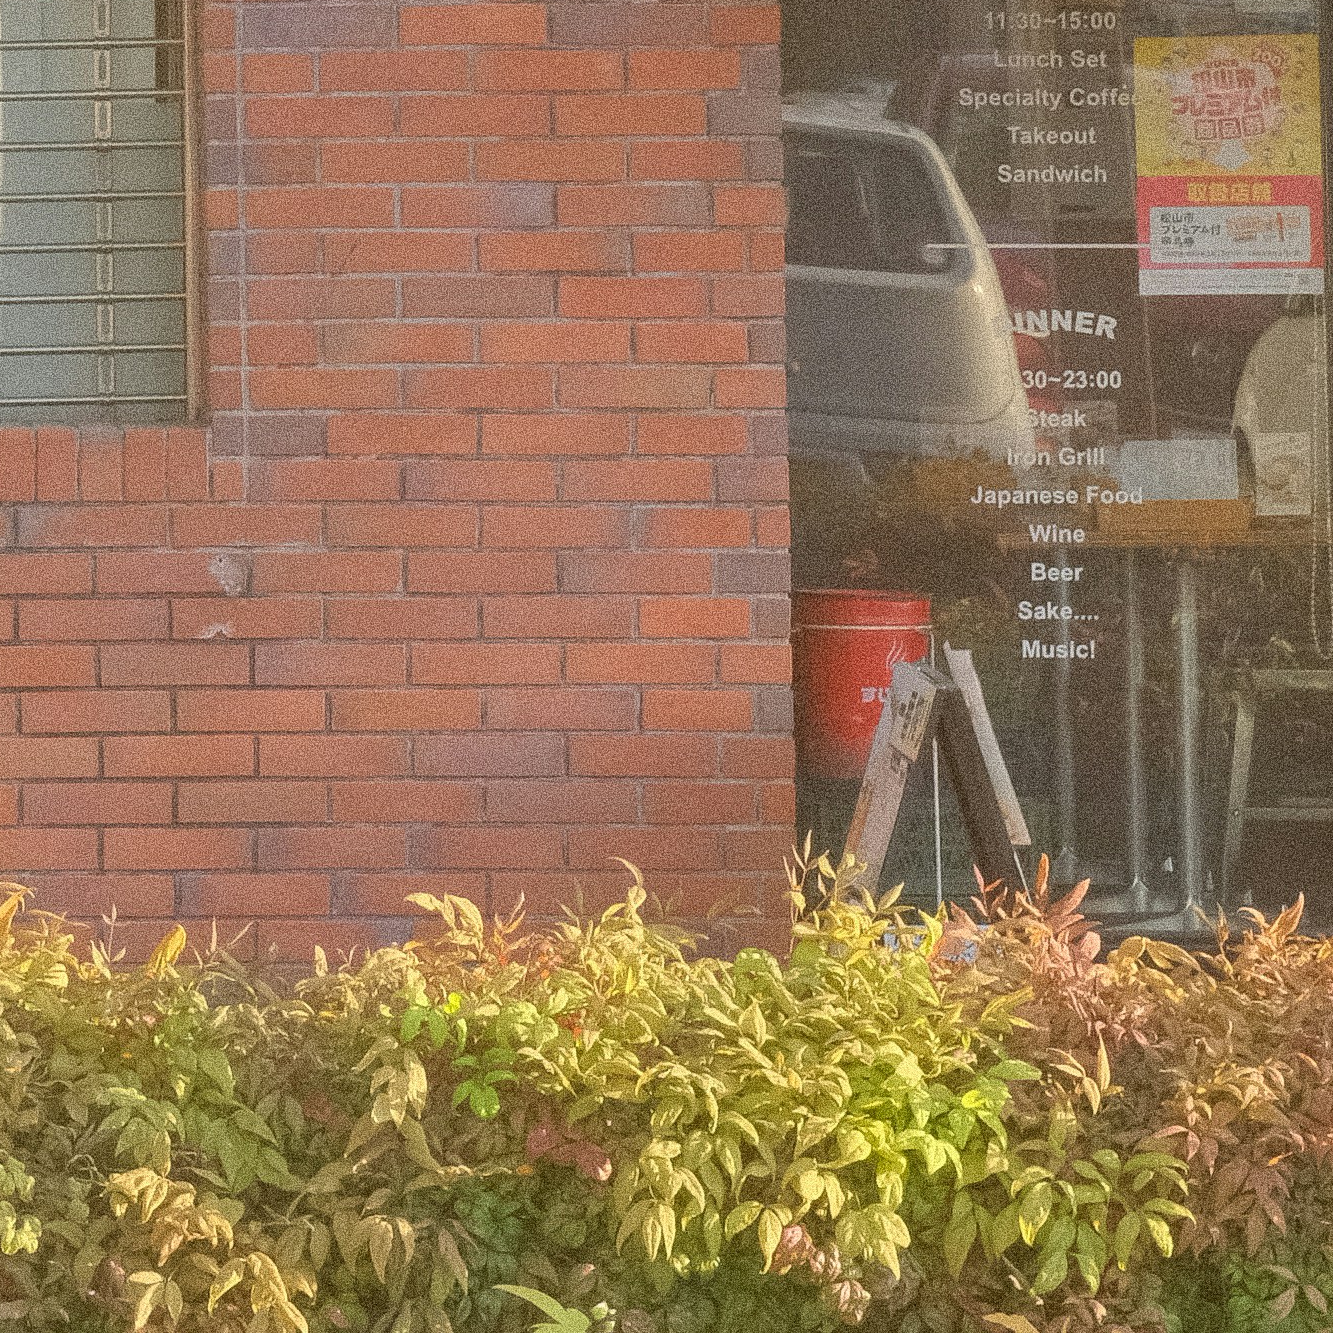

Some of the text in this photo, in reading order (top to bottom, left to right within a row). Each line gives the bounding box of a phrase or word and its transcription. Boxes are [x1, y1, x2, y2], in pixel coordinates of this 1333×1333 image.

[994, 50, 1107, 68] Lunch Set
[959, 88, 1061, 111] Specialty
[1007, 126, 1096, 144] Takeout
[998, 164, 1107, 183] Sandwich
[1026, 409, 1086, 428] Steak
[1007, 447, 1105, 466] Iron Grill
[970, 486, 1143, 509] Japanese Food
[1029, 524, 1086, 543] Wine
[1031, 563, 1084, 582] Beer
[1021, 640, 1096, 659] Music!
